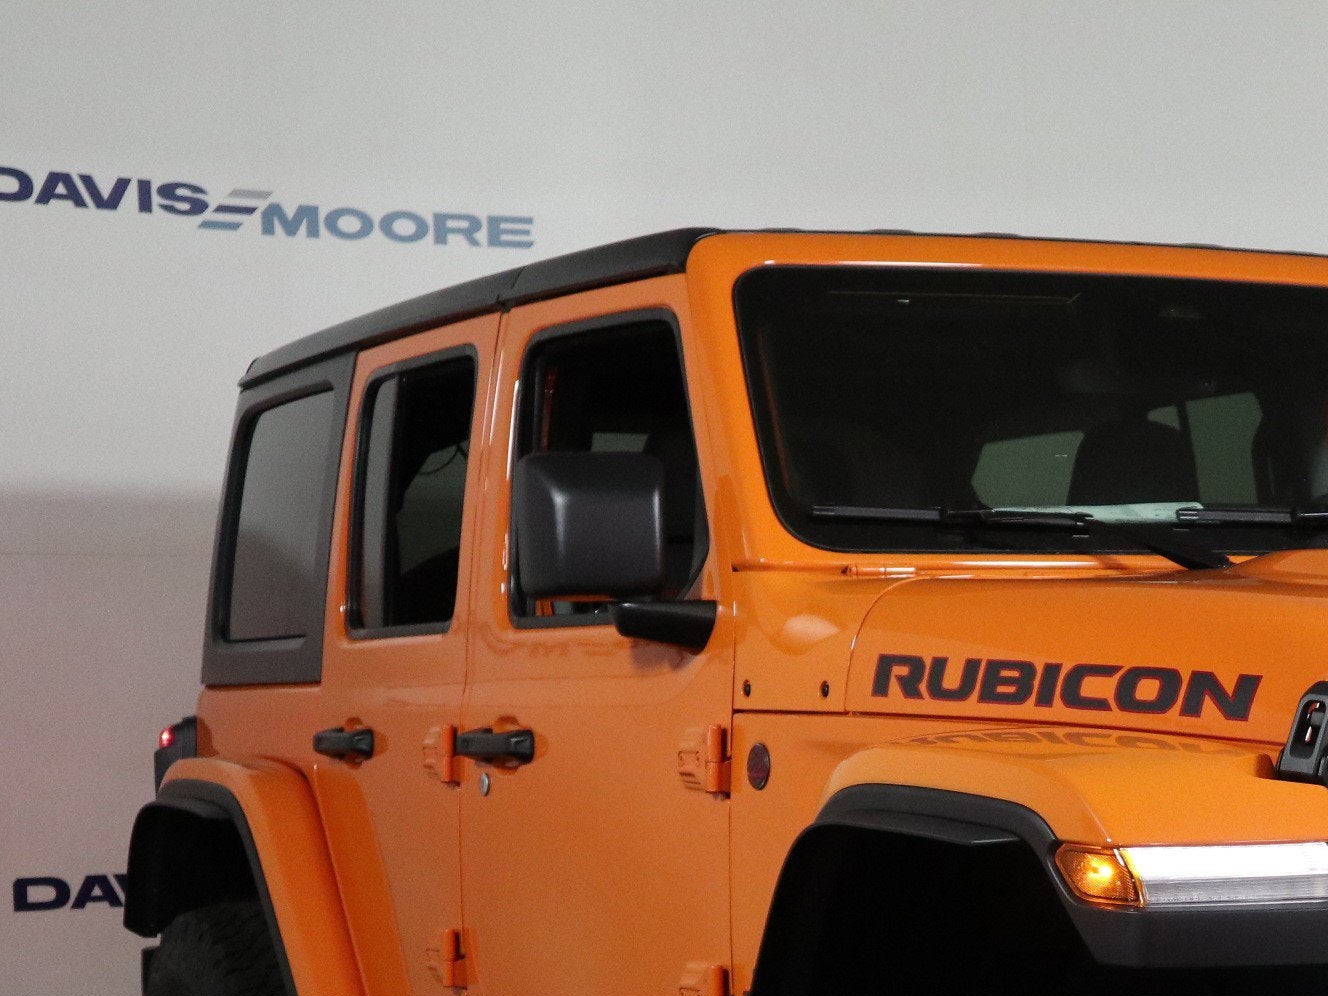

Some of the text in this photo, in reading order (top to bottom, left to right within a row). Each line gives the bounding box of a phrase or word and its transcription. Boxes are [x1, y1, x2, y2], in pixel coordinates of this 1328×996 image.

[0, 166, 535, 249] DAVIS MOORE
[870, 652, 1264, 722] RUBICON
[12, 873, 129, 913] DA
